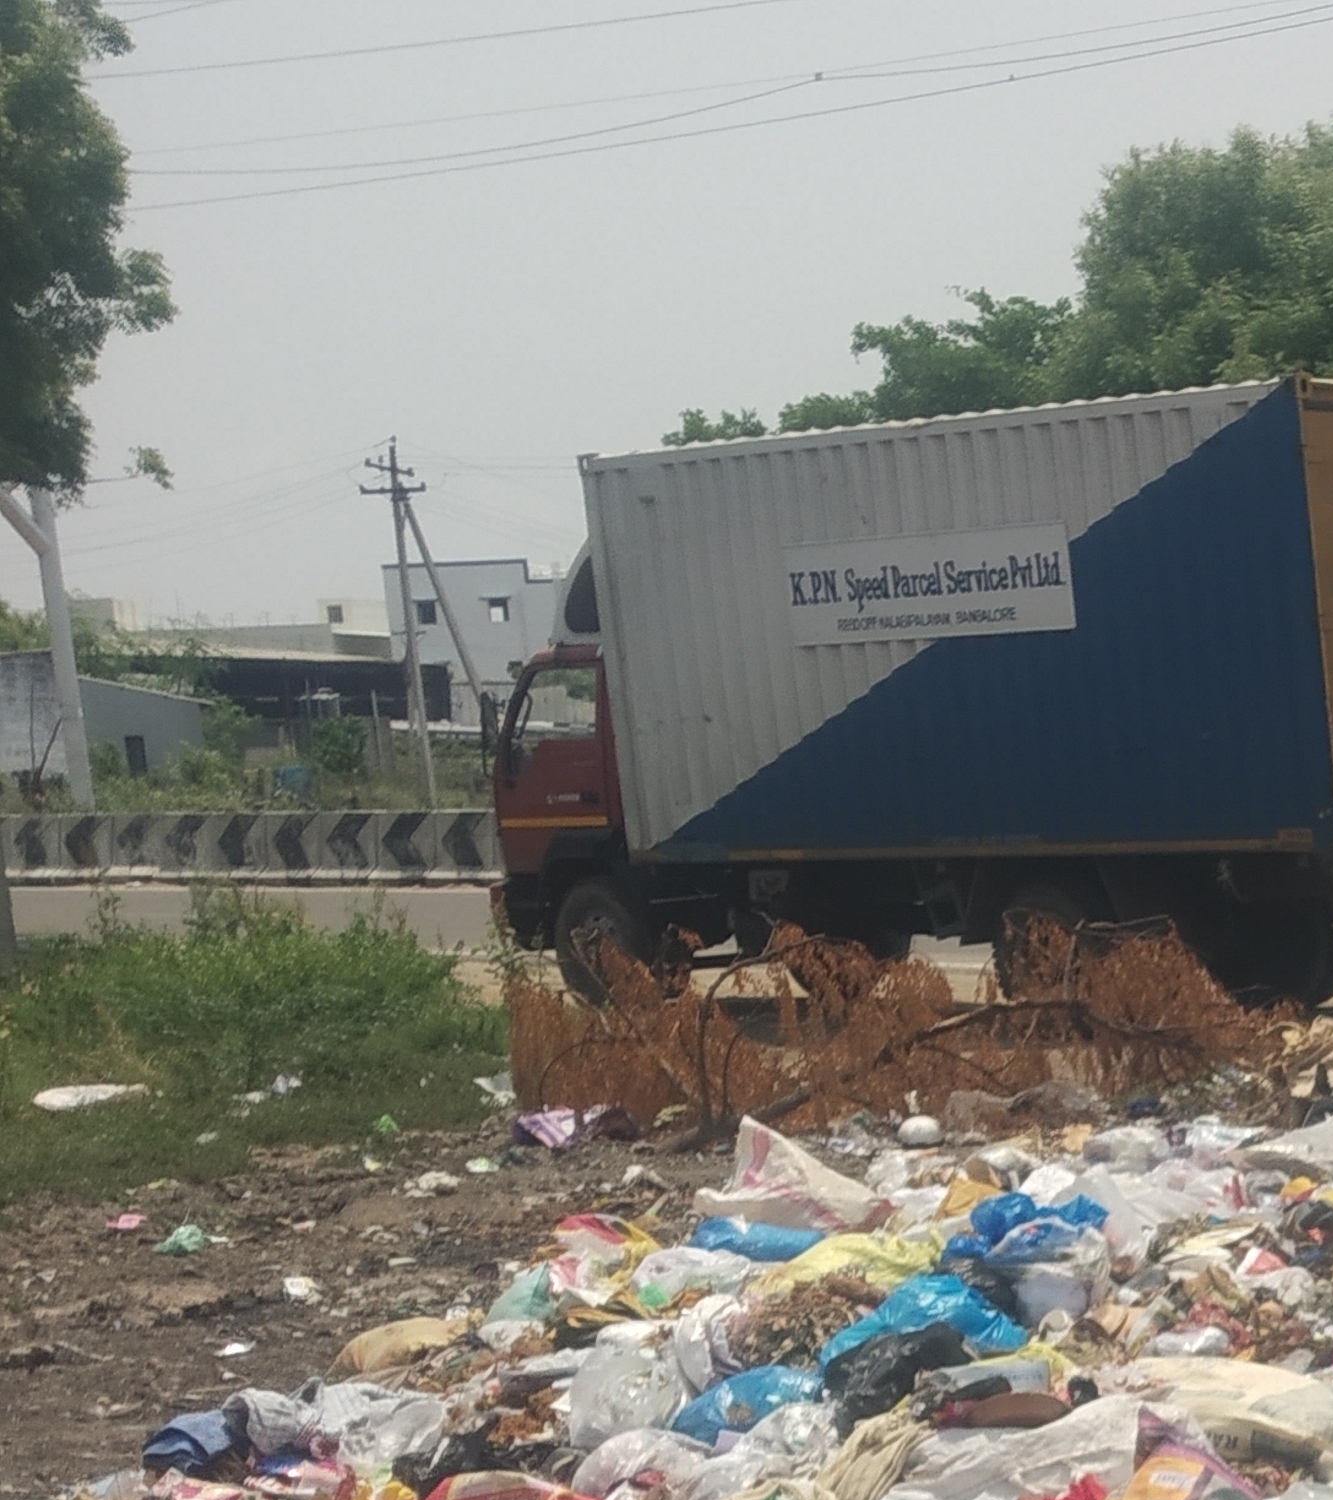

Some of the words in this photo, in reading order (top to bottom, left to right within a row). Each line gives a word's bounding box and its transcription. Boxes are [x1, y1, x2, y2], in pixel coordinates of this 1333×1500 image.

[790, 570, 842, 606] K.P.N.
[845, 565, 891, 613] Speed
[891, 561, 944, 600] Parcel
[945, 560, 1009, 595] Service
